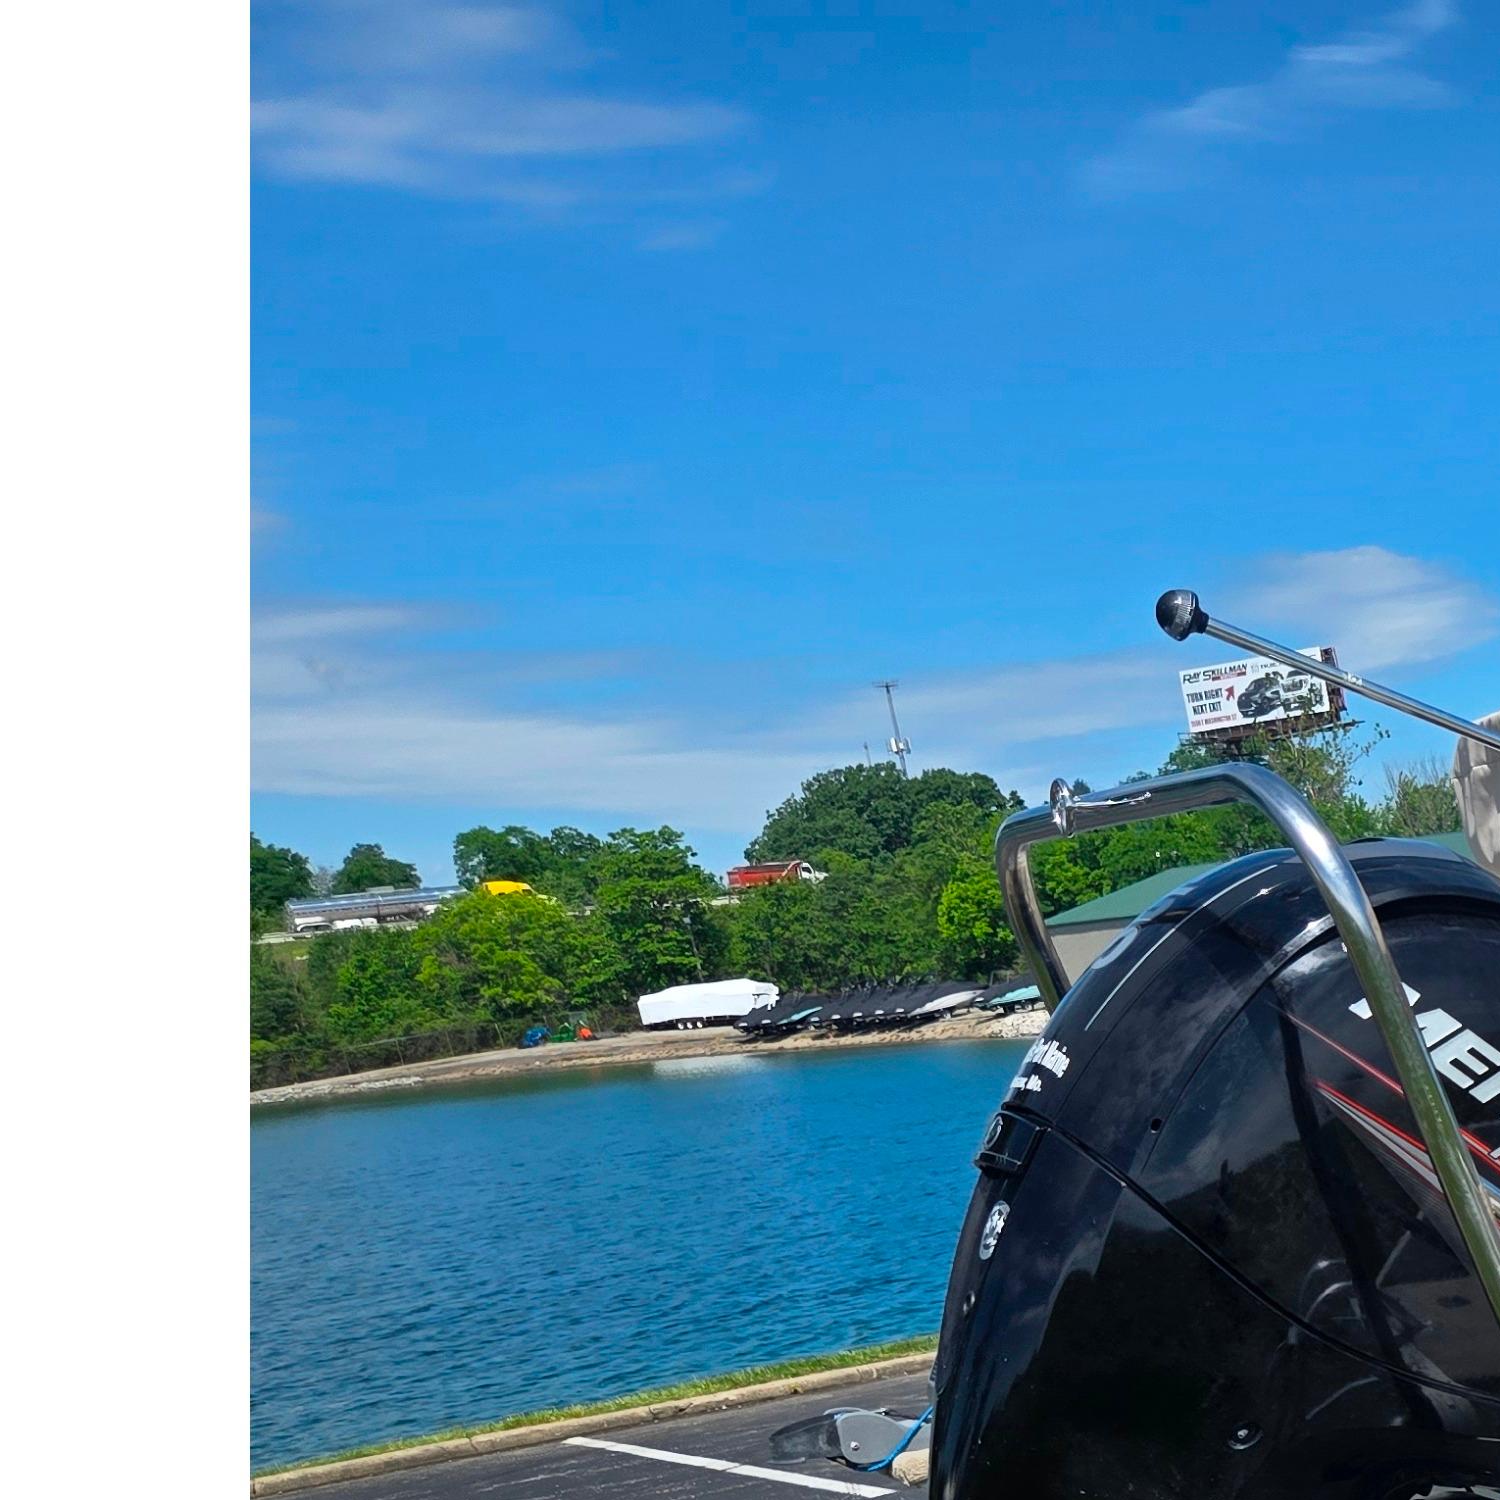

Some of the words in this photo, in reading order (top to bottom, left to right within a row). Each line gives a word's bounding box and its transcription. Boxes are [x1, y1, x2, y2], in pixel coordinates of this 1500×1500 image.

[1183, 671, 1201, 684] RAY
[1203, 663, 1247, 681] SKILLMAN
[1186, 691, 1203, 703] TURN
[1204, 688, 1223, 701] RIGHT
[1192, 703, 1208, 716] NEXT
[1209, 701, 1222, 713] EXIT
